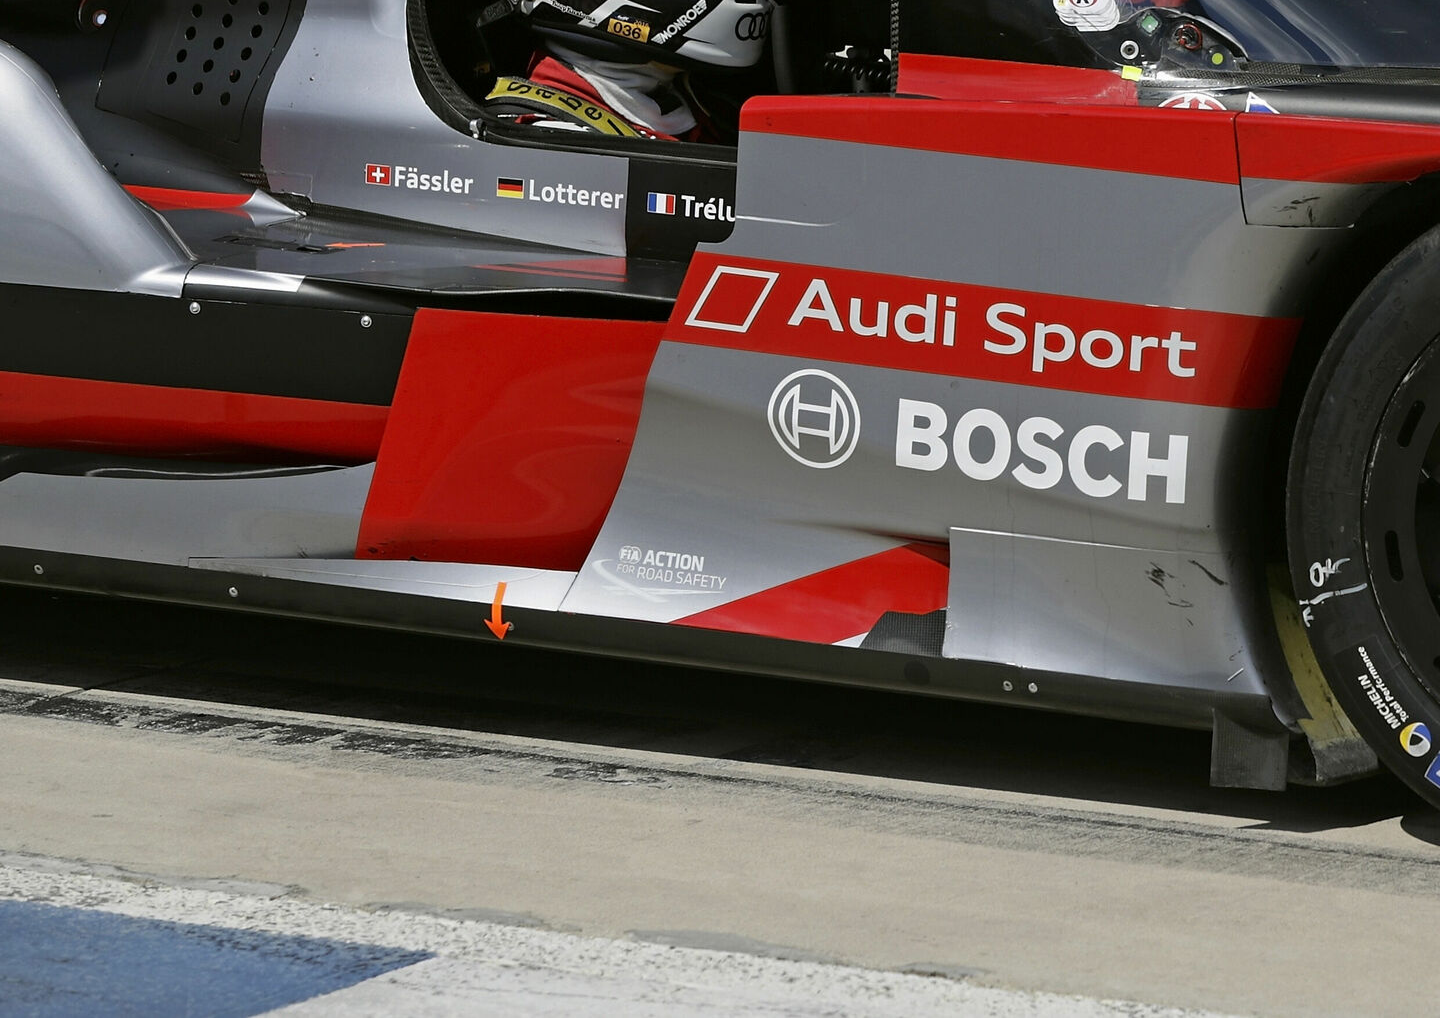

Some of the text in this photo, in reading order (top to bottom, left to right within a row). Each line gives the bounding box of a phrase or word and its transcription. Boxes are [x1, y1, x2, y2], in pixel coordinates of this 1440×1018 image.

[613, 21, 642, 39] 036
[660, 3, 705, 43] MONROE
[393, 165, 474, 195] Fässler
[528, 178, 625, 210] Lotterer
[786, 277, 1198, 379] Audi Sport
[894, 396, 1190, 505] BOSCH
[616, 563, 727, 590] FOR ROAD SAFETY
[643, 549, 705, 572] ACTION
[1357, 645, 1410, 723] Total Performance
[1357, 673, 1401, 730] MICHELIN
